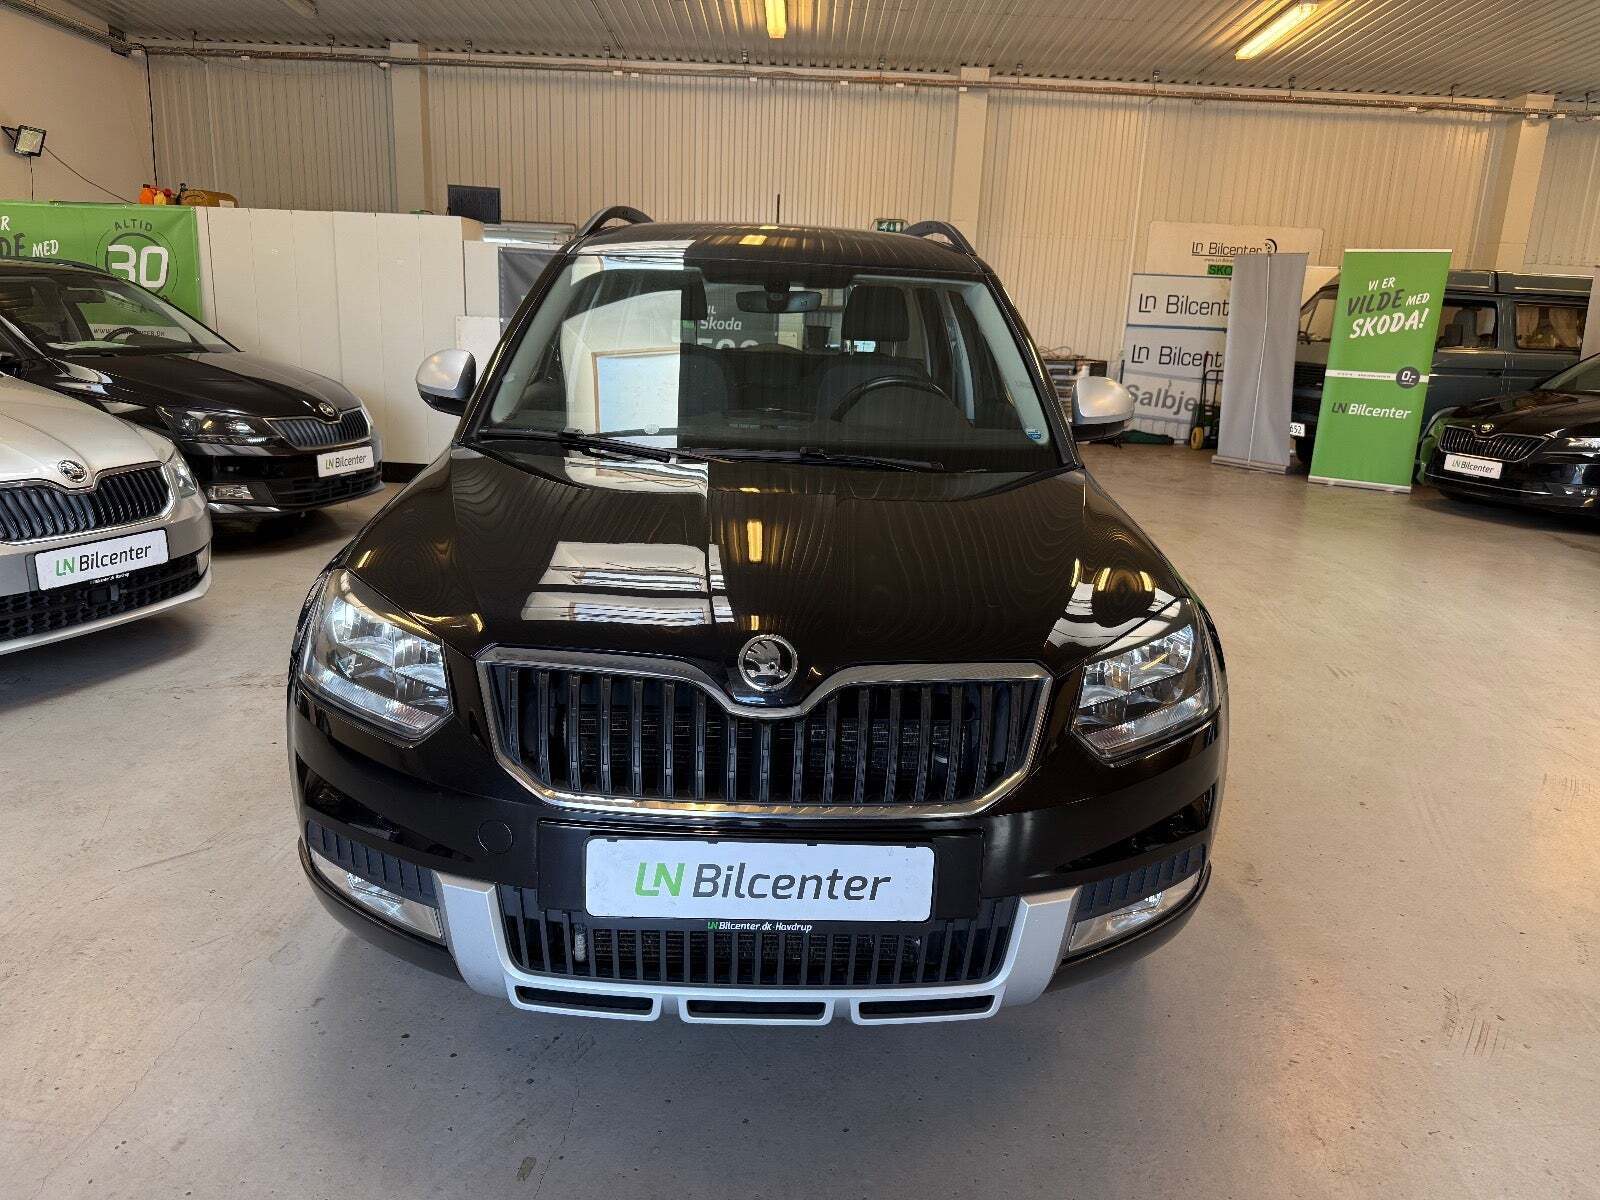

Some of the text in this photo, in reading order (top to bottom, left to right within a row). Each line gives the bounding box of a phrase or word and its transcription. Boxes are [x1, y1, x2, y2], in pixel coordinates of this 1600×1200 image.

[115, 218, 153, 232] ALTID
[32, 239, 59, 257] MED
[107, 244, 169, 288] 30
[1208, 265, 1232, 276] SKO
[1368, 277, 1396, 291] VI ER
[1165, 294, 1229, 316] Bilcent
[1347, 288, 1430, 317] VILDE MED
[1349, 307, 1430, 339] SKODA!
[1158, 346, 1223, 368] Bilcent
[1126, 383, 1197, 415] Salbje
[1348, 403, 1412, 420] Bilcenter
[335, 454, 367, 469] Bilcenter
[1460, 461, 1495, 474] Bilcenter
[55, 545, 152, 577] LN Bilcenter
[635, 862, 892, 900] LN Bilcenter
